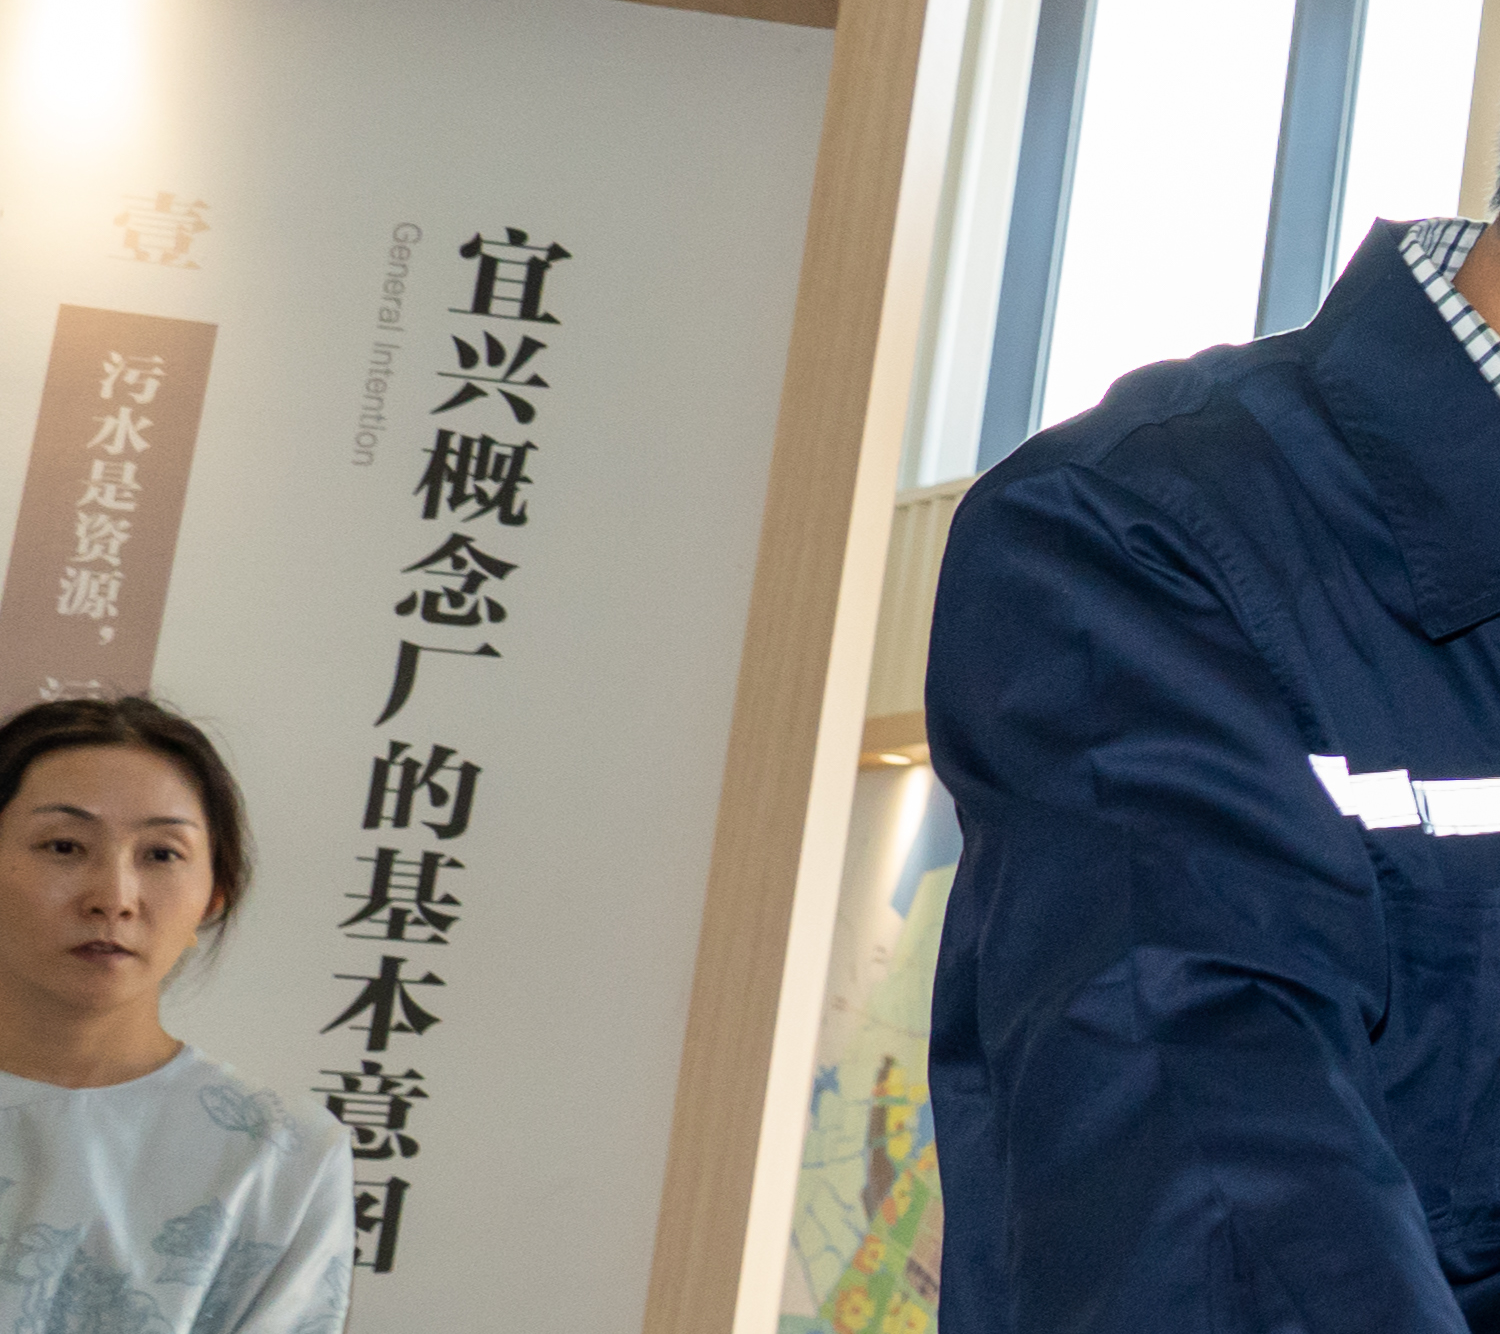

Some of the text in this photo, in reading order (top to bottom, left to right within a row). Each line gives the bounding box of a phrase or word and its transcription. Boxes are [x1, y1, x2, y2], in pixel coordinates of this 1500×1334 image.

[107, 190, 212, 270] 壹
[352, 221, 423, 468] General Intention
